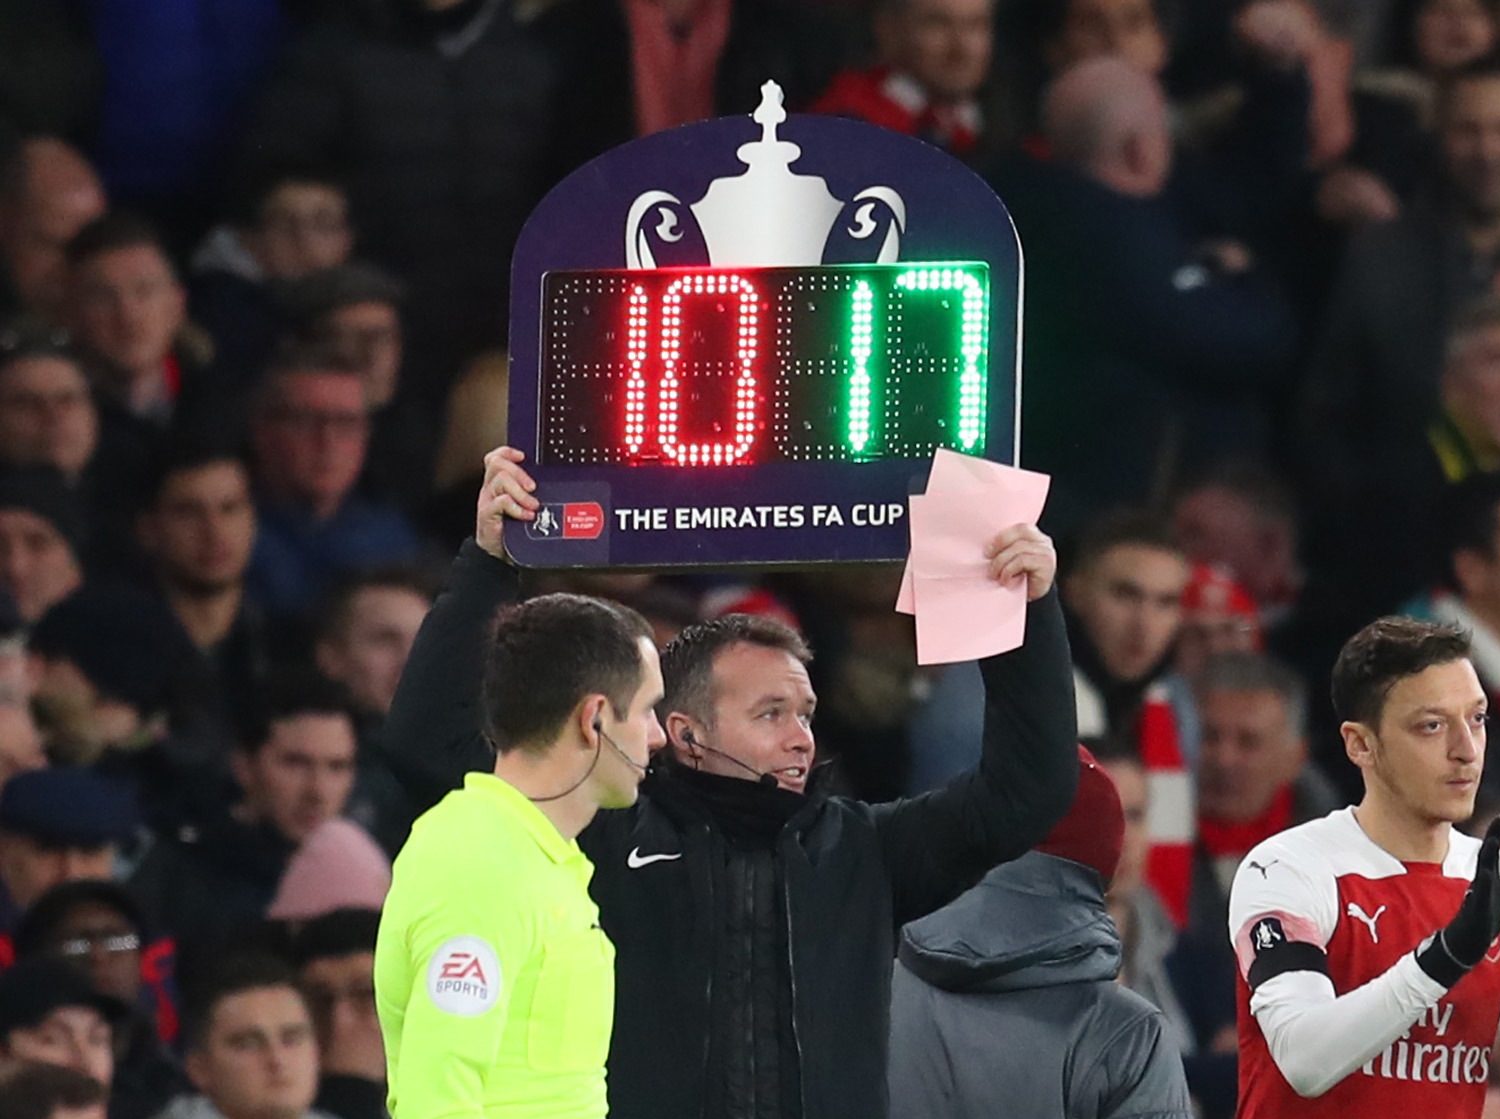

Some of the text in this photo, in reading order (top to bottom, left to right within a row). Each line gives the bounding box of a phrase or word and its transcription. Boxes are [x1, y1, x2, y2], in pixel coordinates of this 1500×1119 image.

[625, 268, 984, 464] 10 17
[614, 503, 905, 531] THE EMIRATES FA CUP
[439, 953, 487, 985] EA
[436, 980, 488, 1000] SPORTS
